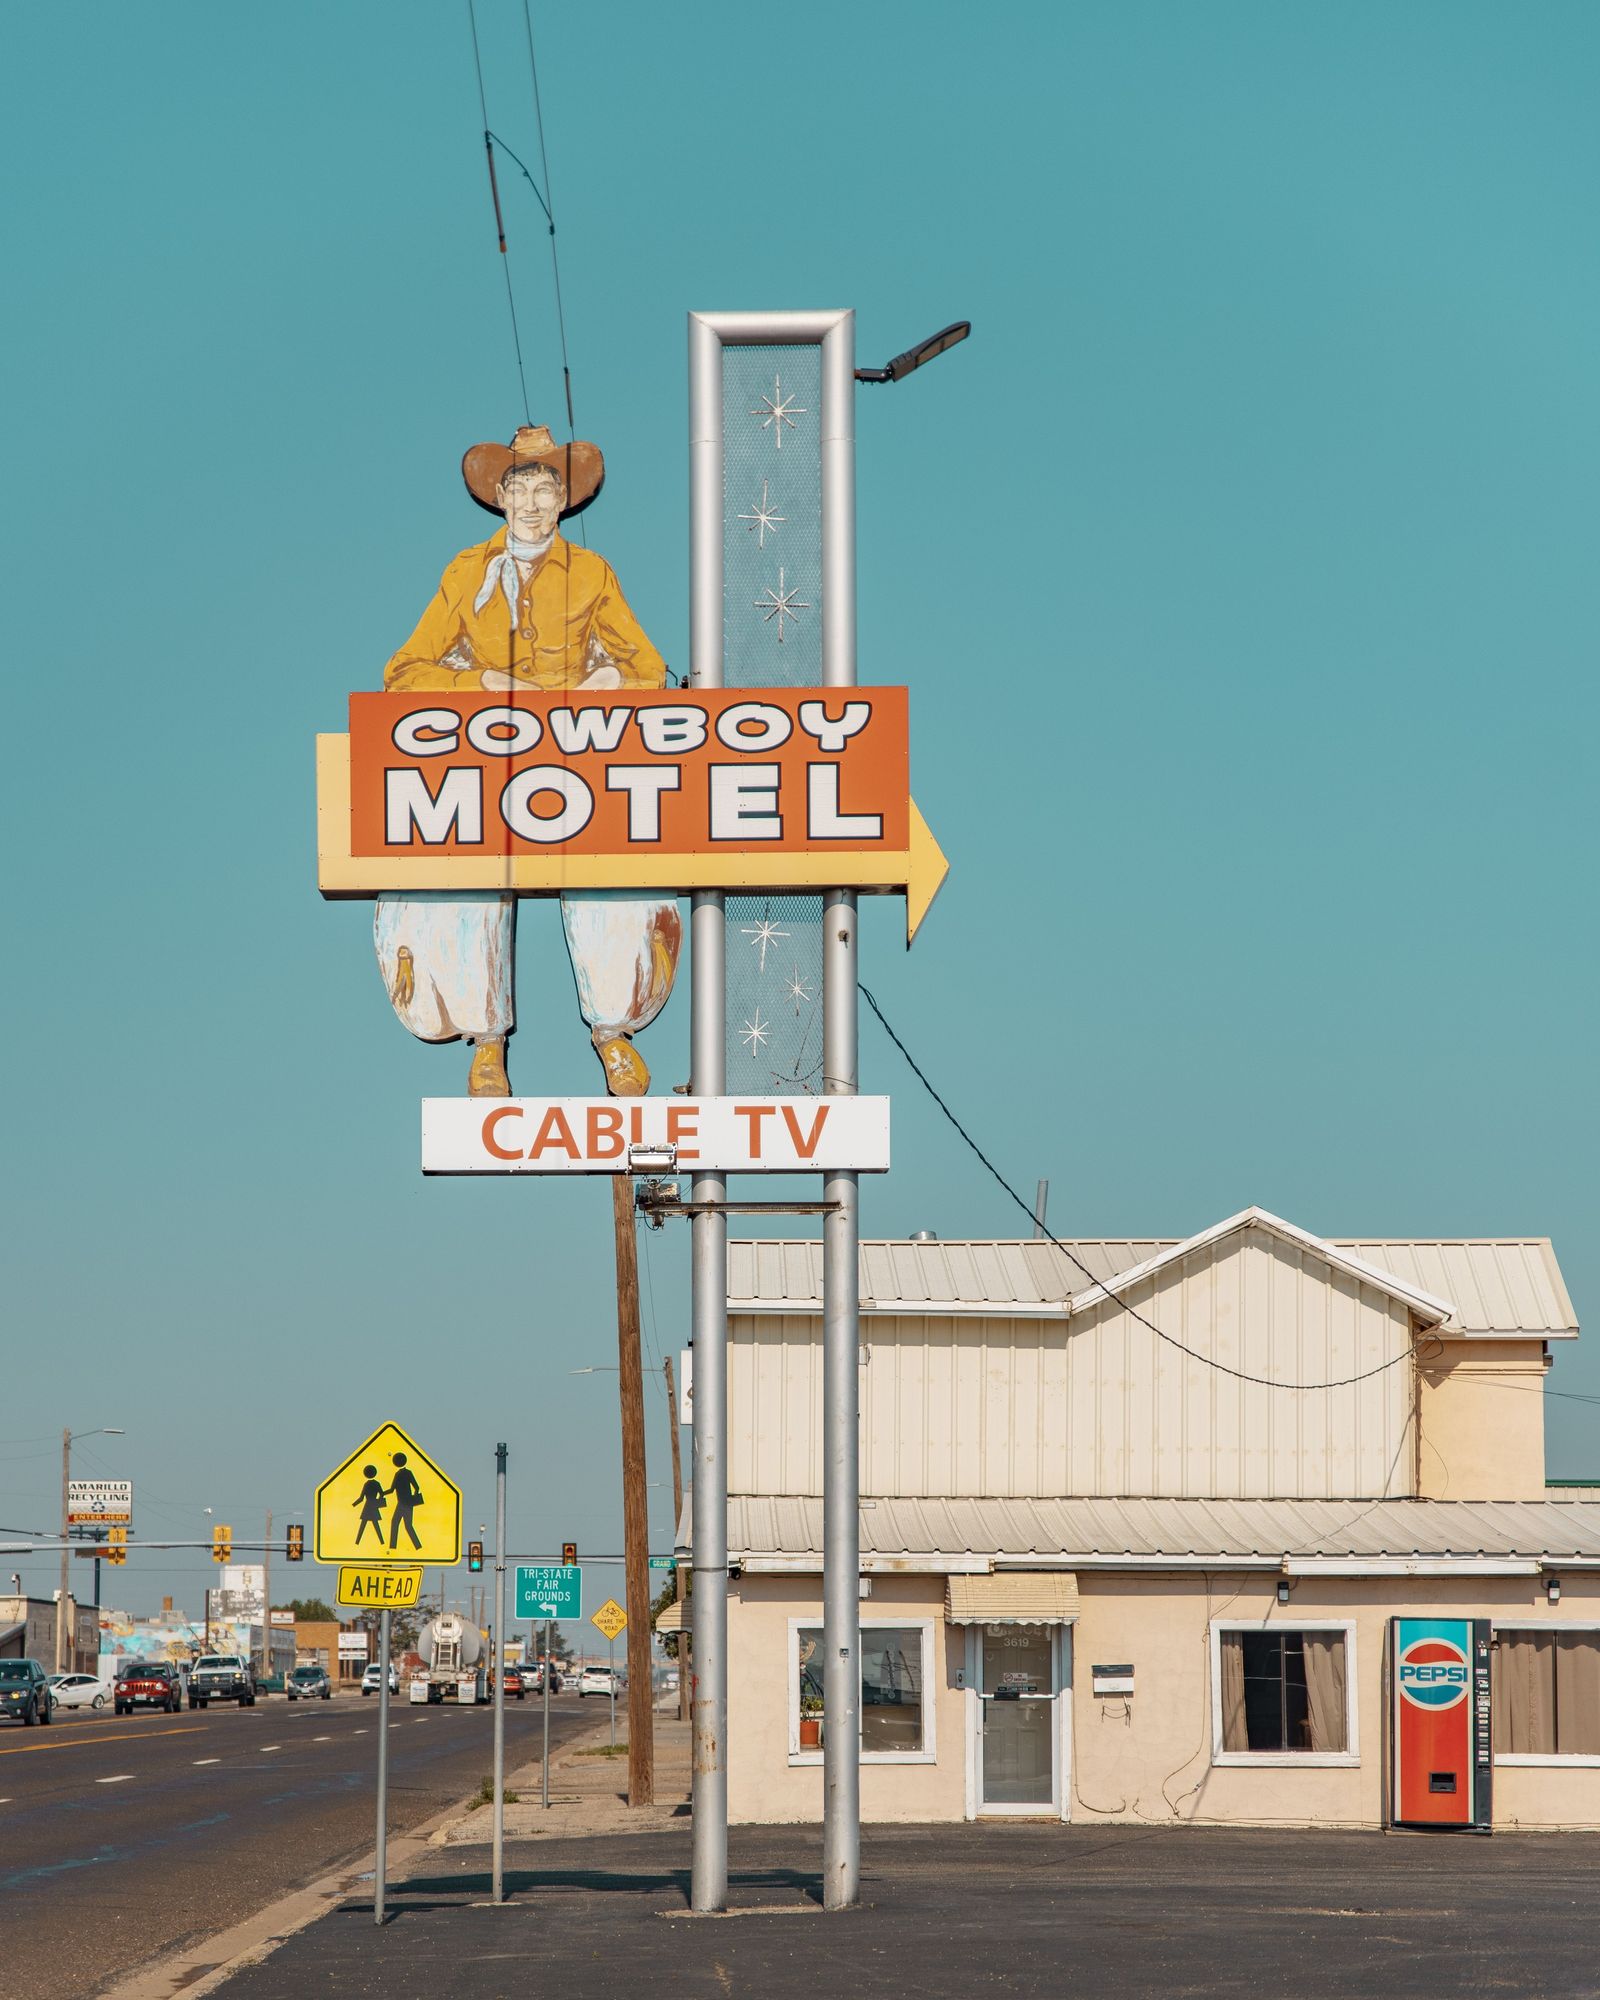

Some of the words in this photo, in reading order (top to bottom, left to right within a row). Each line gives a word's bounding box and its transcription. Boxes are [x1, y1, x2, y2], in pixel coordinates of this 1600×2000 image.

[391, 700, 872, 757] COWBOY
[384, 761, 884, 846] MOTEL
[734, 1105, 831, 1159] TV
[69, 1483, 128, 1491] AMARILLO
[68, 1493, 129, 1501] RECYCLING
[522, 1568, 574, 1580] TRI-STATE
[350, 1575, 413, 1599] AHEAD
[536, 1579, 559, 1590] FAIR
[524, 1590, 571, 1602] GROUNDS
[1003, 1637, 1029, 1648] 3619
[1399, 1665, 1469, 1683] PEPSI
